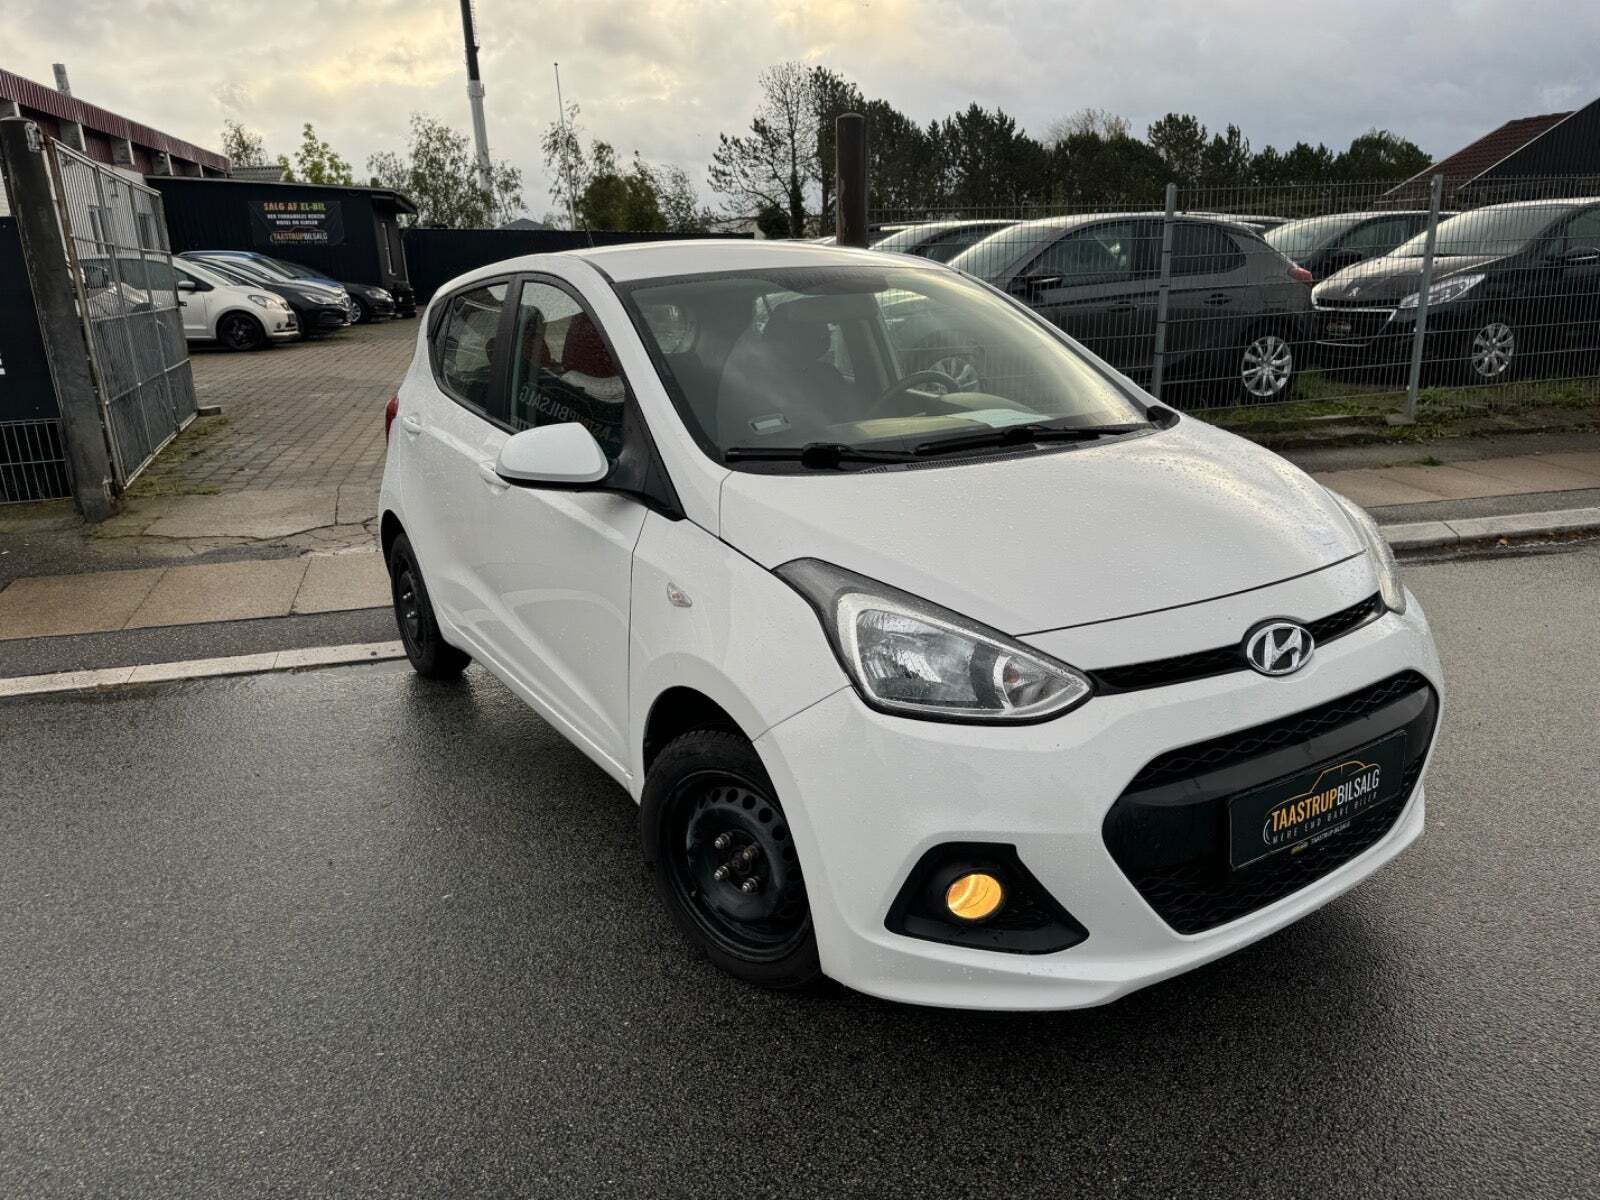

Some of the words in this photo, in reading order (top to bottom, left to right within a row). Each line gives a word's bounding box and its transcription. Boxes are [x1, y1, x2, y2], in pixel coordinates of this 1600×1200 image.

[264, 202, 285, 211] SALG
[287, 202, 298, 211] AF
[300, 202, 326, 211] EL-BIL
[1271, 769, 1380, 832] TAASTRUPBILSALG
